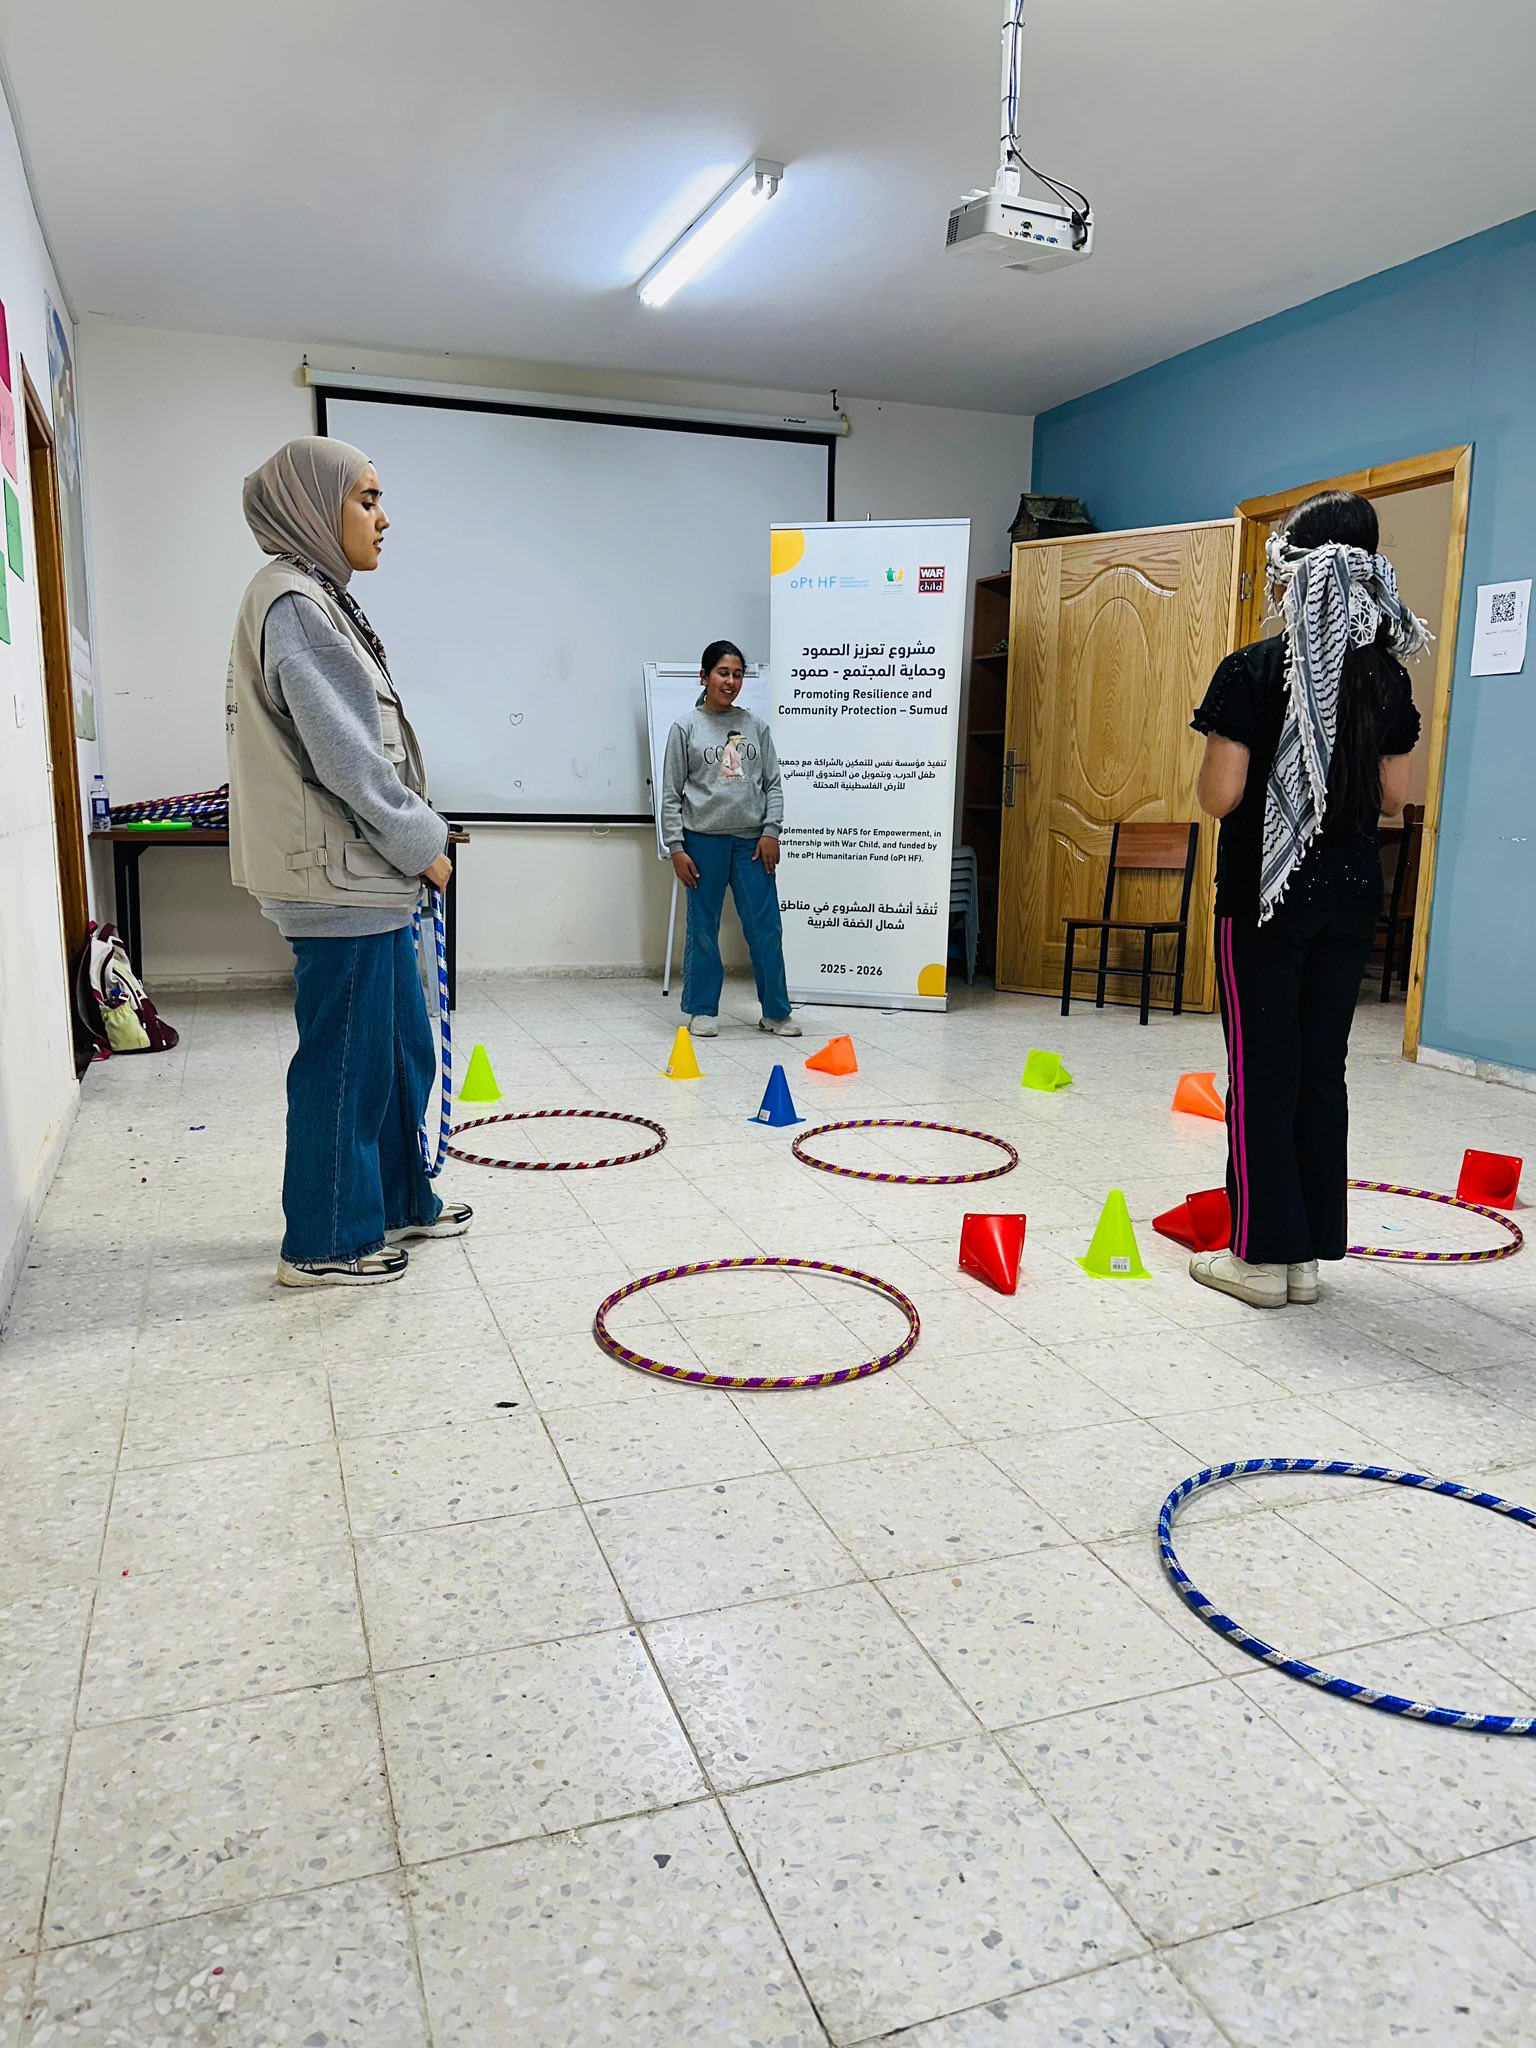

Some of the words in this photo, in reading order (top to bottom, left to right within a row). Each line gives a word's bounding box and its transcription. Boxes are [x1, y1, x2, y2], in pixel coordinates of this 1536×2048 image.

[920, 568, 944, 578] WAR
[790, 576, 814, 589] oPt
[818, 576, 837, 588] HF
[920, 582, 942, 592] child
[802, 644, 850, 659] الصمود
[853, 644, 885, 659] تعزيز
[888, 640, 936, 659] مشروع
[791, 668, 828, 680] صمود
[843, 664, 896, 680] المجتمع
[900, 664, 946, 680] وحماية
[794, 688, 850, 700] Promoting
[852, 688, 909, 699] Resilience
[912, 688, 932, 699] and
[778, 705, 838, 717] Community
[841, 705, 896, 715] Protection
[909, 704, 948, 715] Sumud
[801, 760, 812, 768] مع
[814, 758, 844, 768] بالشراكة
[845, 758, 873, 768] للتمكين
[874, 759, 894, 768] نفس
[895, 758, 925, 768] مؤسسة
[816, 770, 847, 779] الصندوق
[861, 770, 892, 780] وبتمويل
[918, 770, 936, 780] طفل
[812, 781, 838, 789] المحتلة
[840, 781, 882, 790] الفلسطينية
[781, 827, 824, 836] plemented
[826, 828, 835, 836] by
[836, 828, 858, 836] NAFS
[860, 828, 872, 836] for
[873, 828, 932, 838] Empowerment,
[824, 840, 840, 848] with
[842, 840, 856, 848] War
[858, 840, 880, 849] Child,
[882, 841, 896, 849] and
[898, 841, 926, 849] funded
[927, 842, 938, 851] by
[816, 852, 868, 861] Humanitarian
[890, 854, 906, 862] (oPt
[908, 854, 924, 863] HF).
[780, 900, 810, 912] مناطق
[813, 902, 830, 916] في
[832, 901, 874, 914] المشروع
[878, 902, 913, 914] أنشطة
[807, 917, 840, 929] الغربية
[842, 918, 872, 929] الضفة
[876, 919, 905, 932] شمال
[820, 964, 846, 974] 2025
[856, 966, 883, 976] 2026
